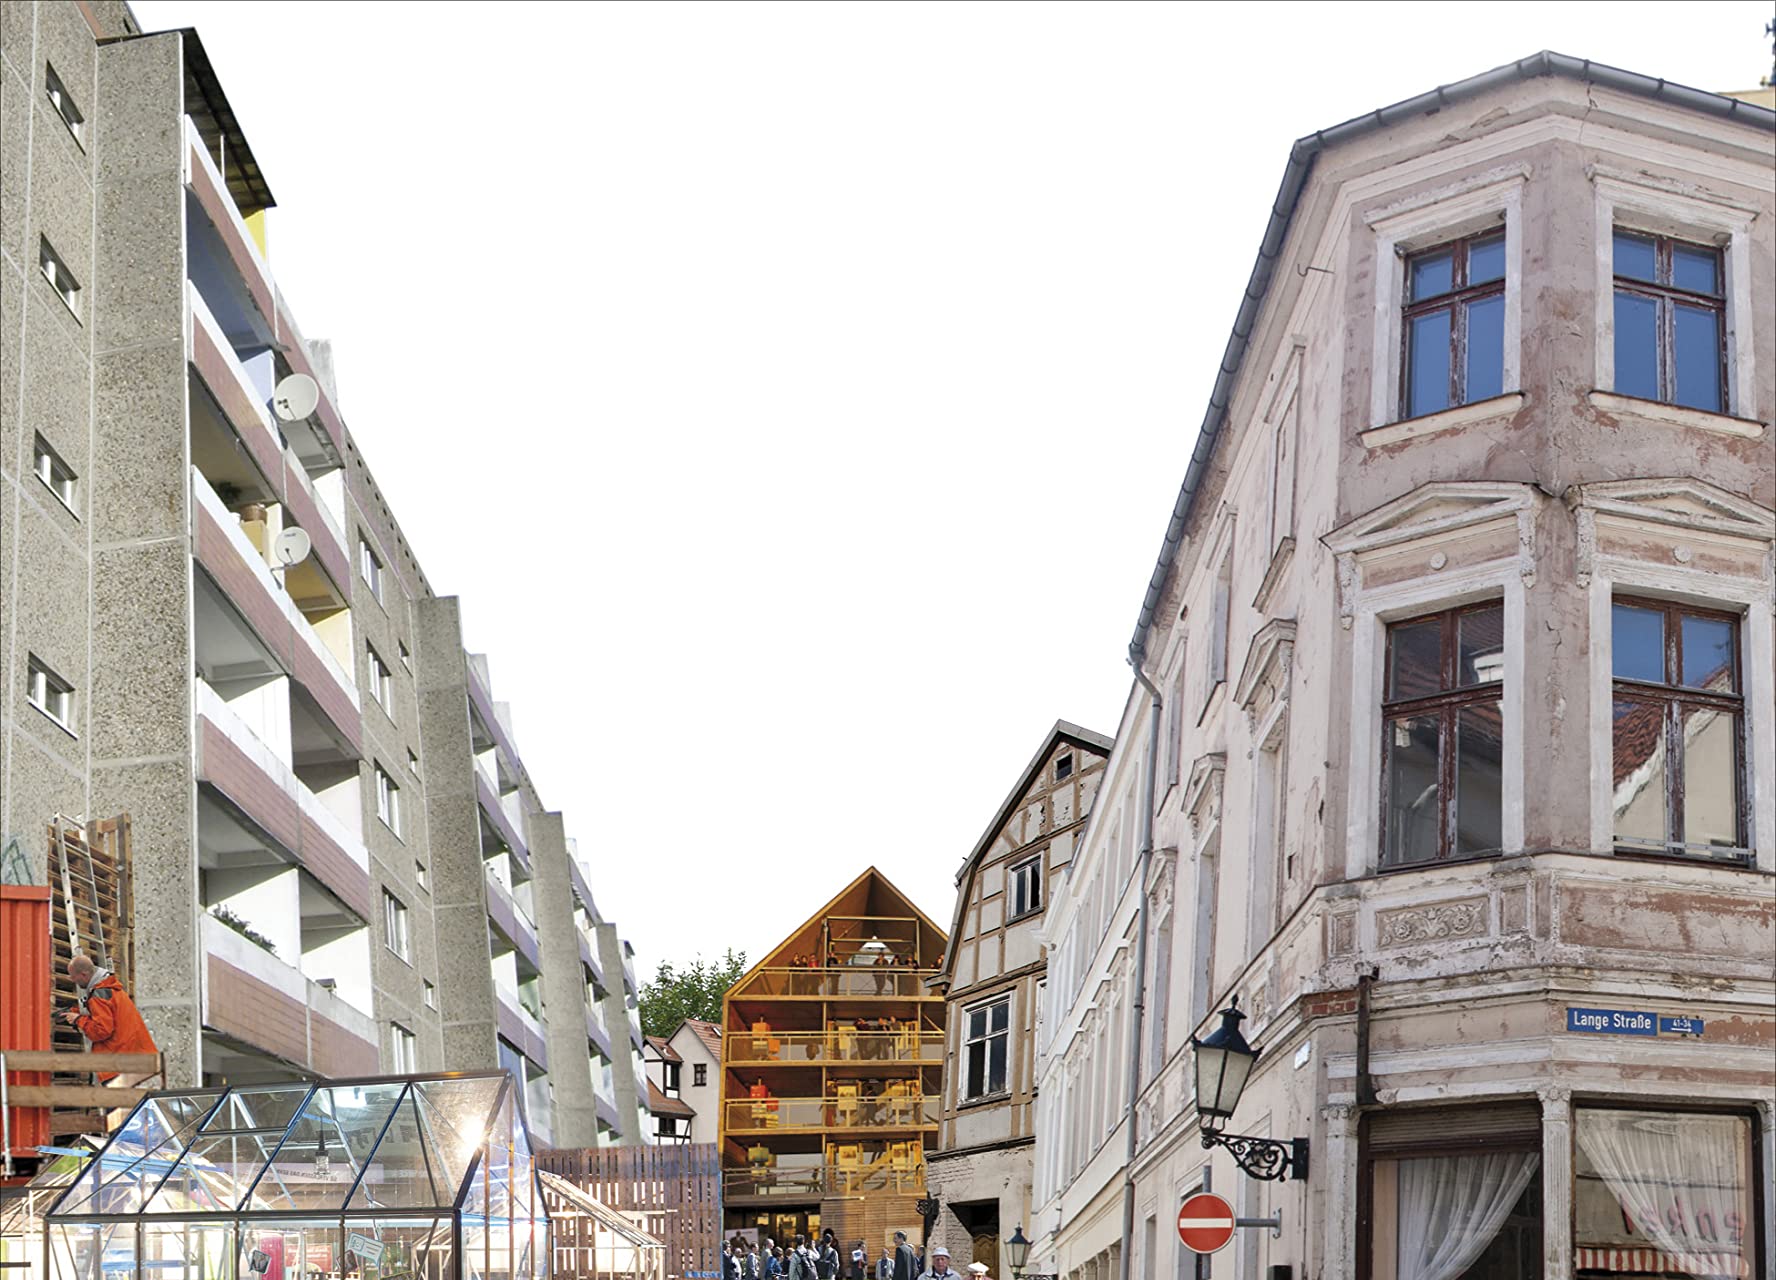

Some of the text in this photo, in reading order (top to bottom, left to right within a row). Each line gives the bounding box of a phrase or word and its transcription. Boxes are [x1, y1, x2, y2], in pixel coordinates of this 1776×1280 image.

[1573, 1010, 1652, 1030] Lange Straße
[1672, 1018, 1692, 1028] 41-34
